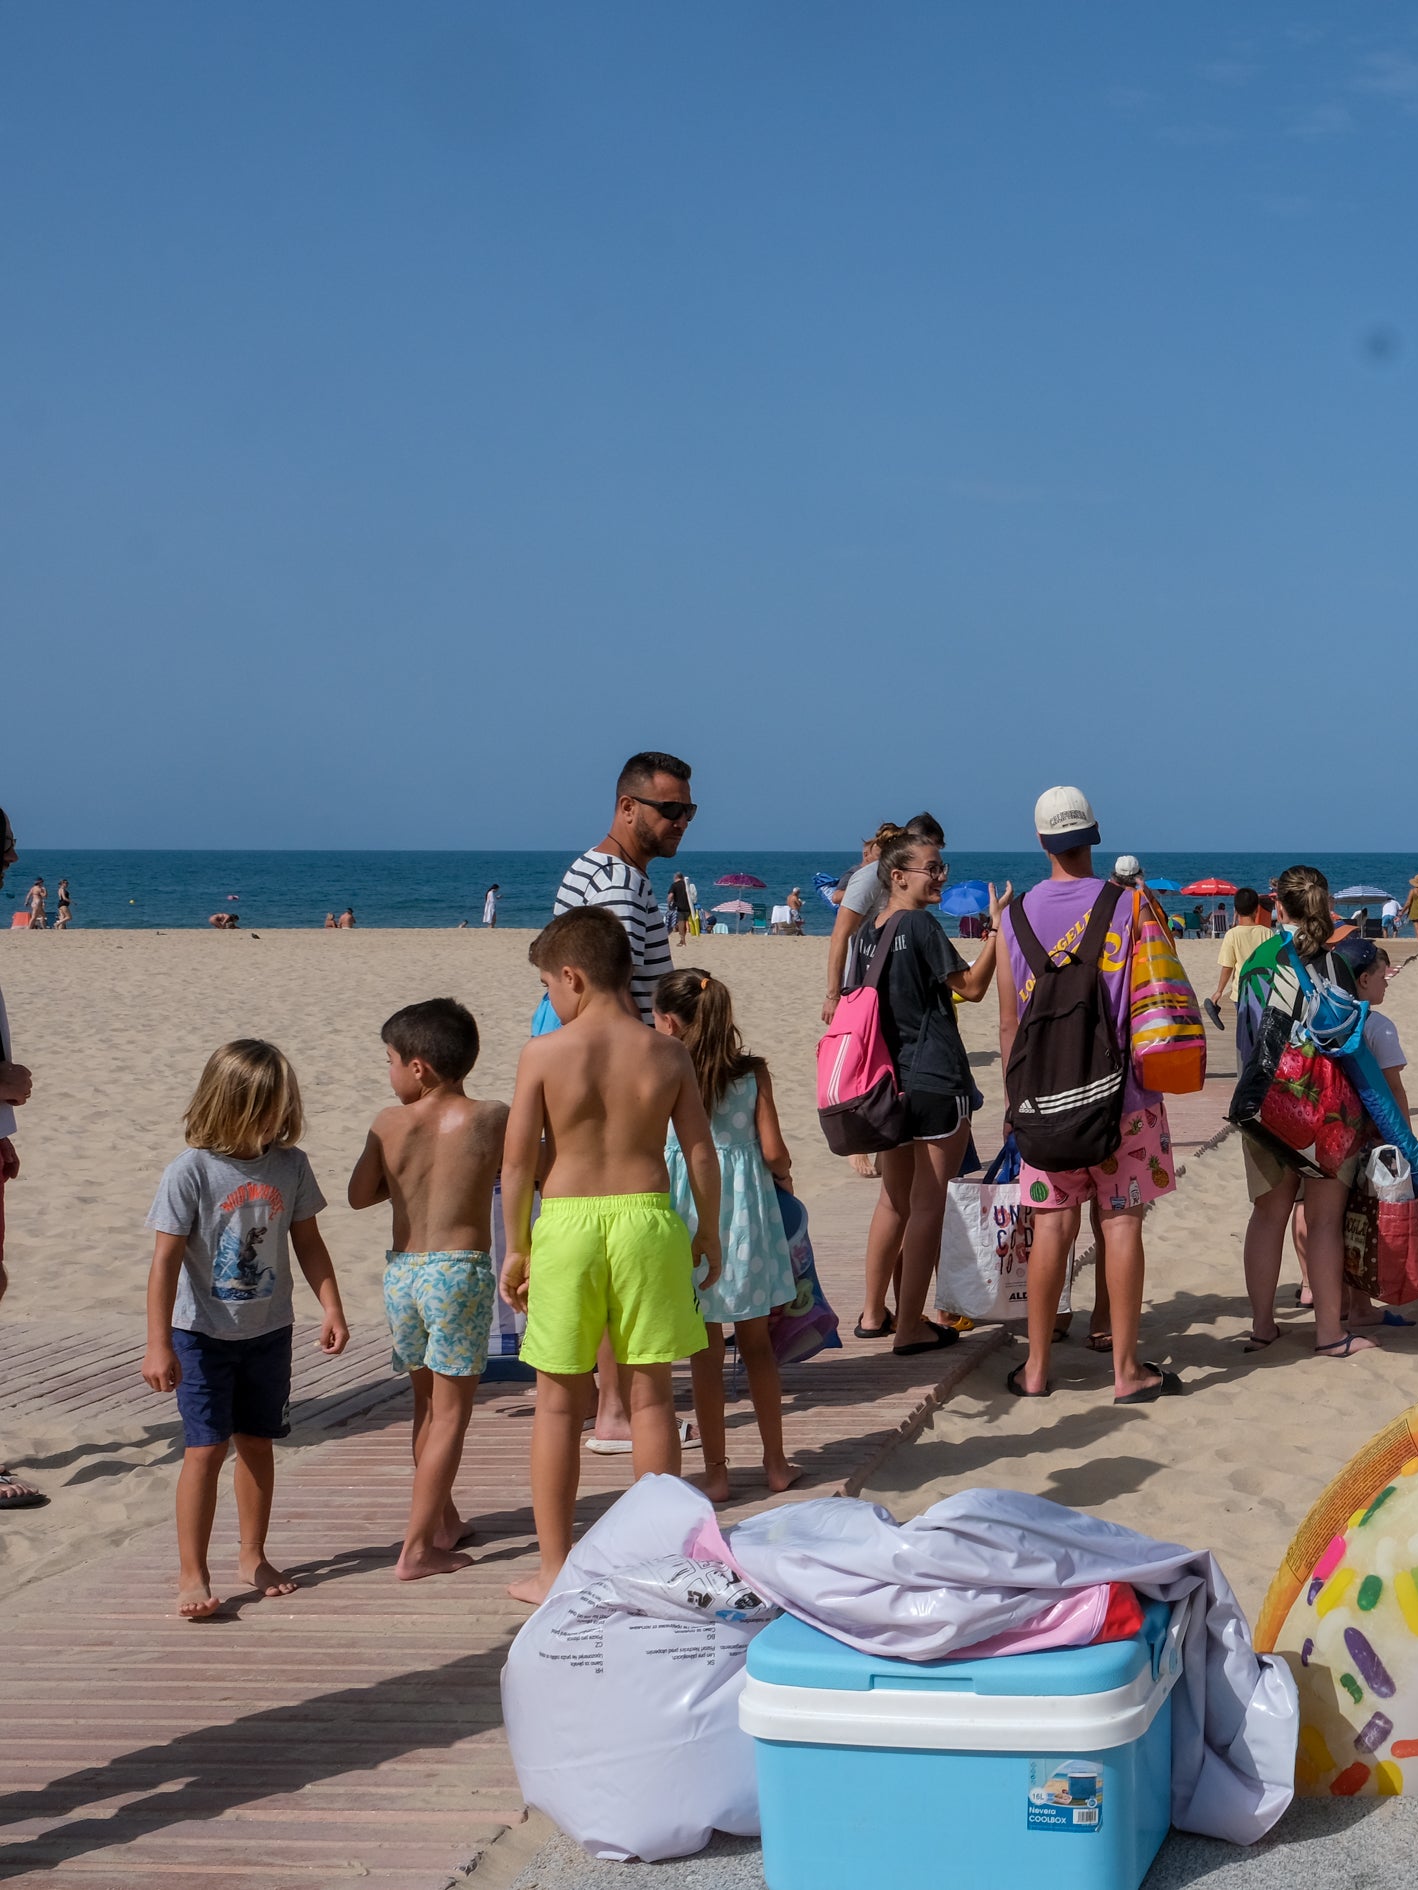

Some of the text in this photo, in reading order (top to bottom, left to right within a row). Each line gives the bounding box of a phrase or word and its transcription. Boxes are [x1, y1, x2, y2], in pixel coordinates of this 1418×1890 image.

[1019, 973, 1036, 1003] LO
[994, 1204, 1032, 1226] UNP
[997, 1229, 1034, 1251] COD
[1032, 1793, 1045, 1801] 16L
[1029, 1806, 1056, 1815] Nevera
[1028, 1815, 1067, 1824] COOLBOX
